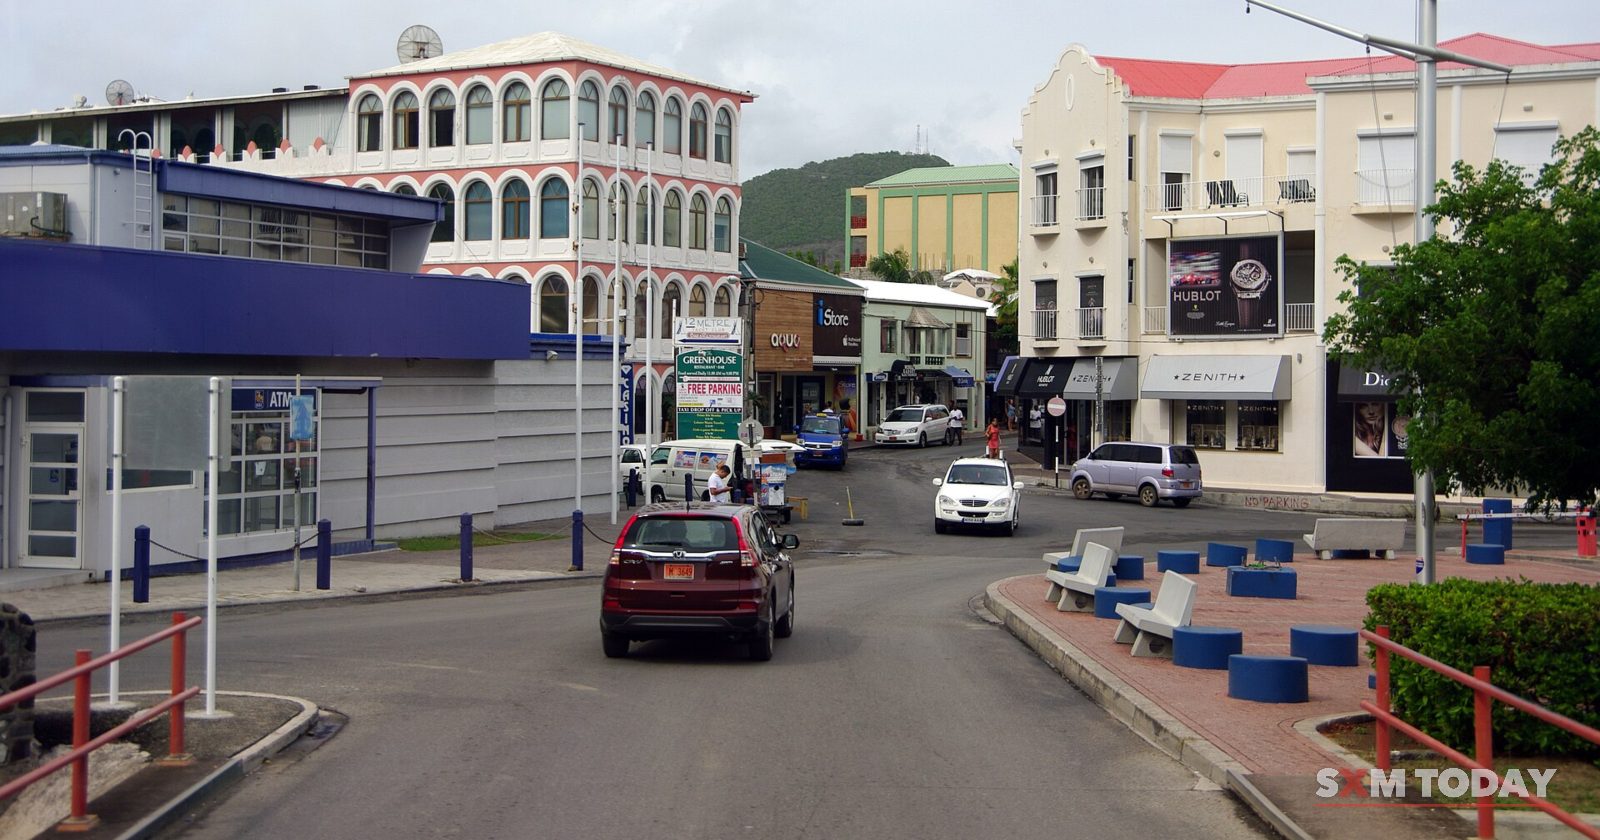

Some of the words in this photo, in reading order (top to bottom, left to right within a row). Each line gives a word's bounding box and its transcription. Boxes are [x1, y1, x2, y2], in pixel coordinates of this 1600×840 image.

[1173, 291, 1221, 301] HUBLOT
[817, 299, 849, 326] iStore
[685, 318, 696, 326] 12
[697, 319, 731, 328] METRE
[683, 356, 737, 364] GREENHOUSE
[1182, 373, 1237, 381] ZENITH
[688, 384, 706, 394] FREE
[709, 384, 742, 394] PARKING
[270, 391, 292, 407] ATM
[622, 378, 630, 445] CASINO
[1245, 496, 1258, 507] NO
[1263, 496, 1310, 509] PARKING
